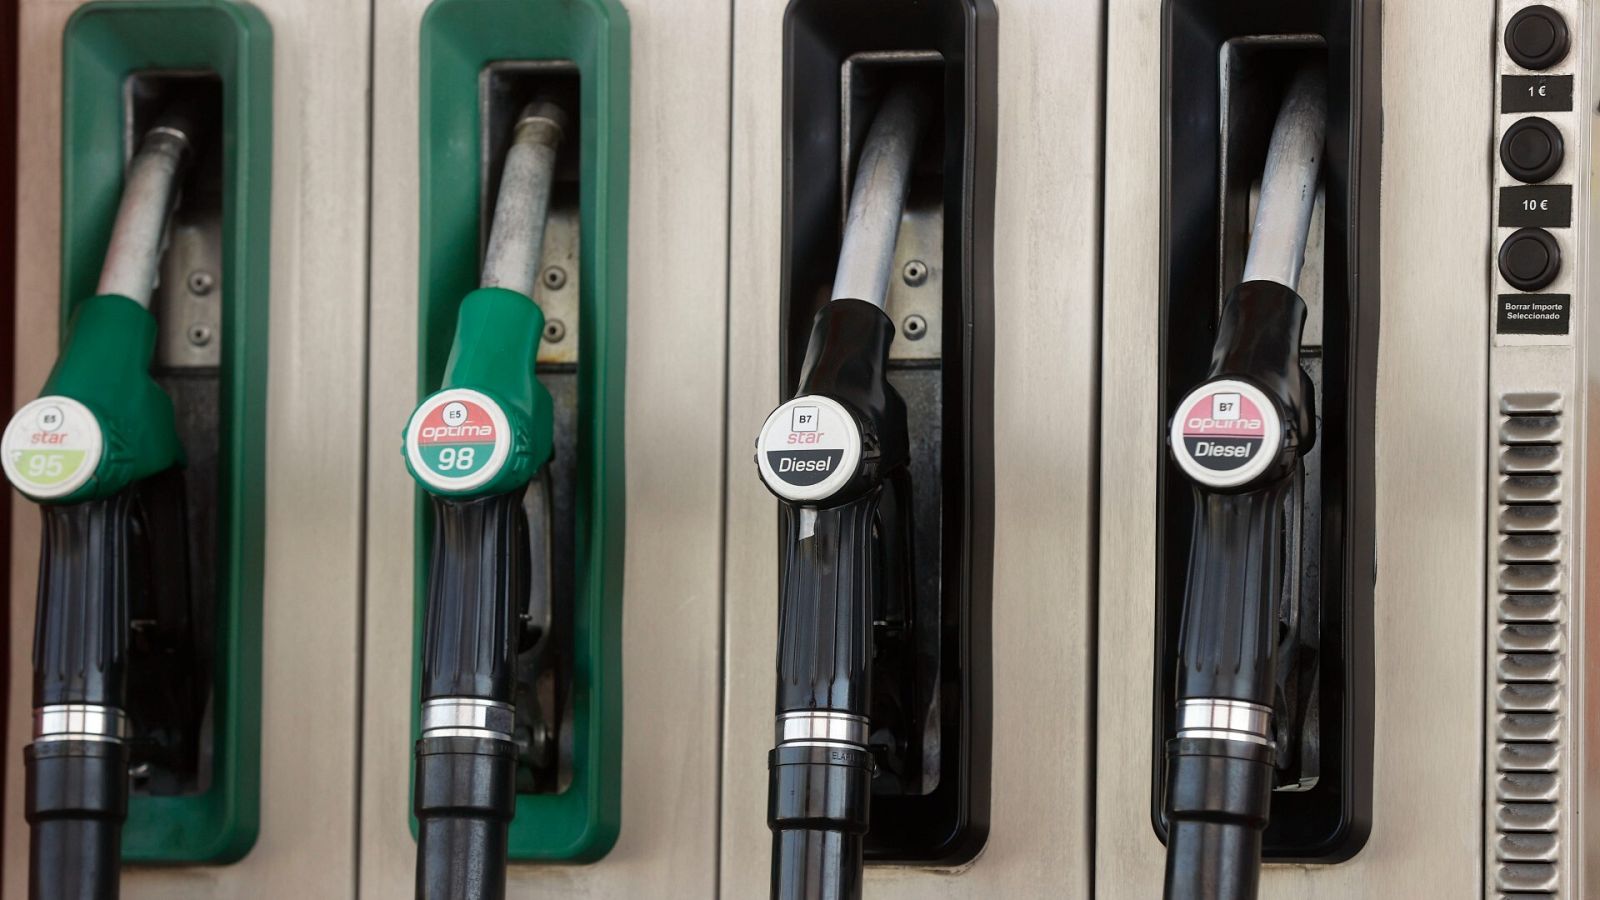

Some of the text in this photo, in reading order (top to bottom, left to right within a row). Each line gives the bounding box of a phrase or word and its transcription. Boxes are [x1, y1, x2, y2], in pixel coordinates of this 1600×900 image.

[1528, 85, 1546, 97] 1 €
[1522, 199, 1548, 211] 10 €
[1505, 302, 1563, 312] Borrar Importe
[1507, 312, 1560, 320] Seleccionado
[1219, 403, 1233, 412] B7
[43, 415, 56, 424] E5
[449, 411, 461, 419] E5
[799, 415, 812, 424] B7
[422, 421, 492, 441] optima
[31, 431, 68, 445] star
[787, 431, 825, 445] star
[1194, 441, 1252, 458] Diesel
[438, 447, 475, 471] 98
[778, 456, 832, 473] Diesel
[28, 454, 64, 477] 95
